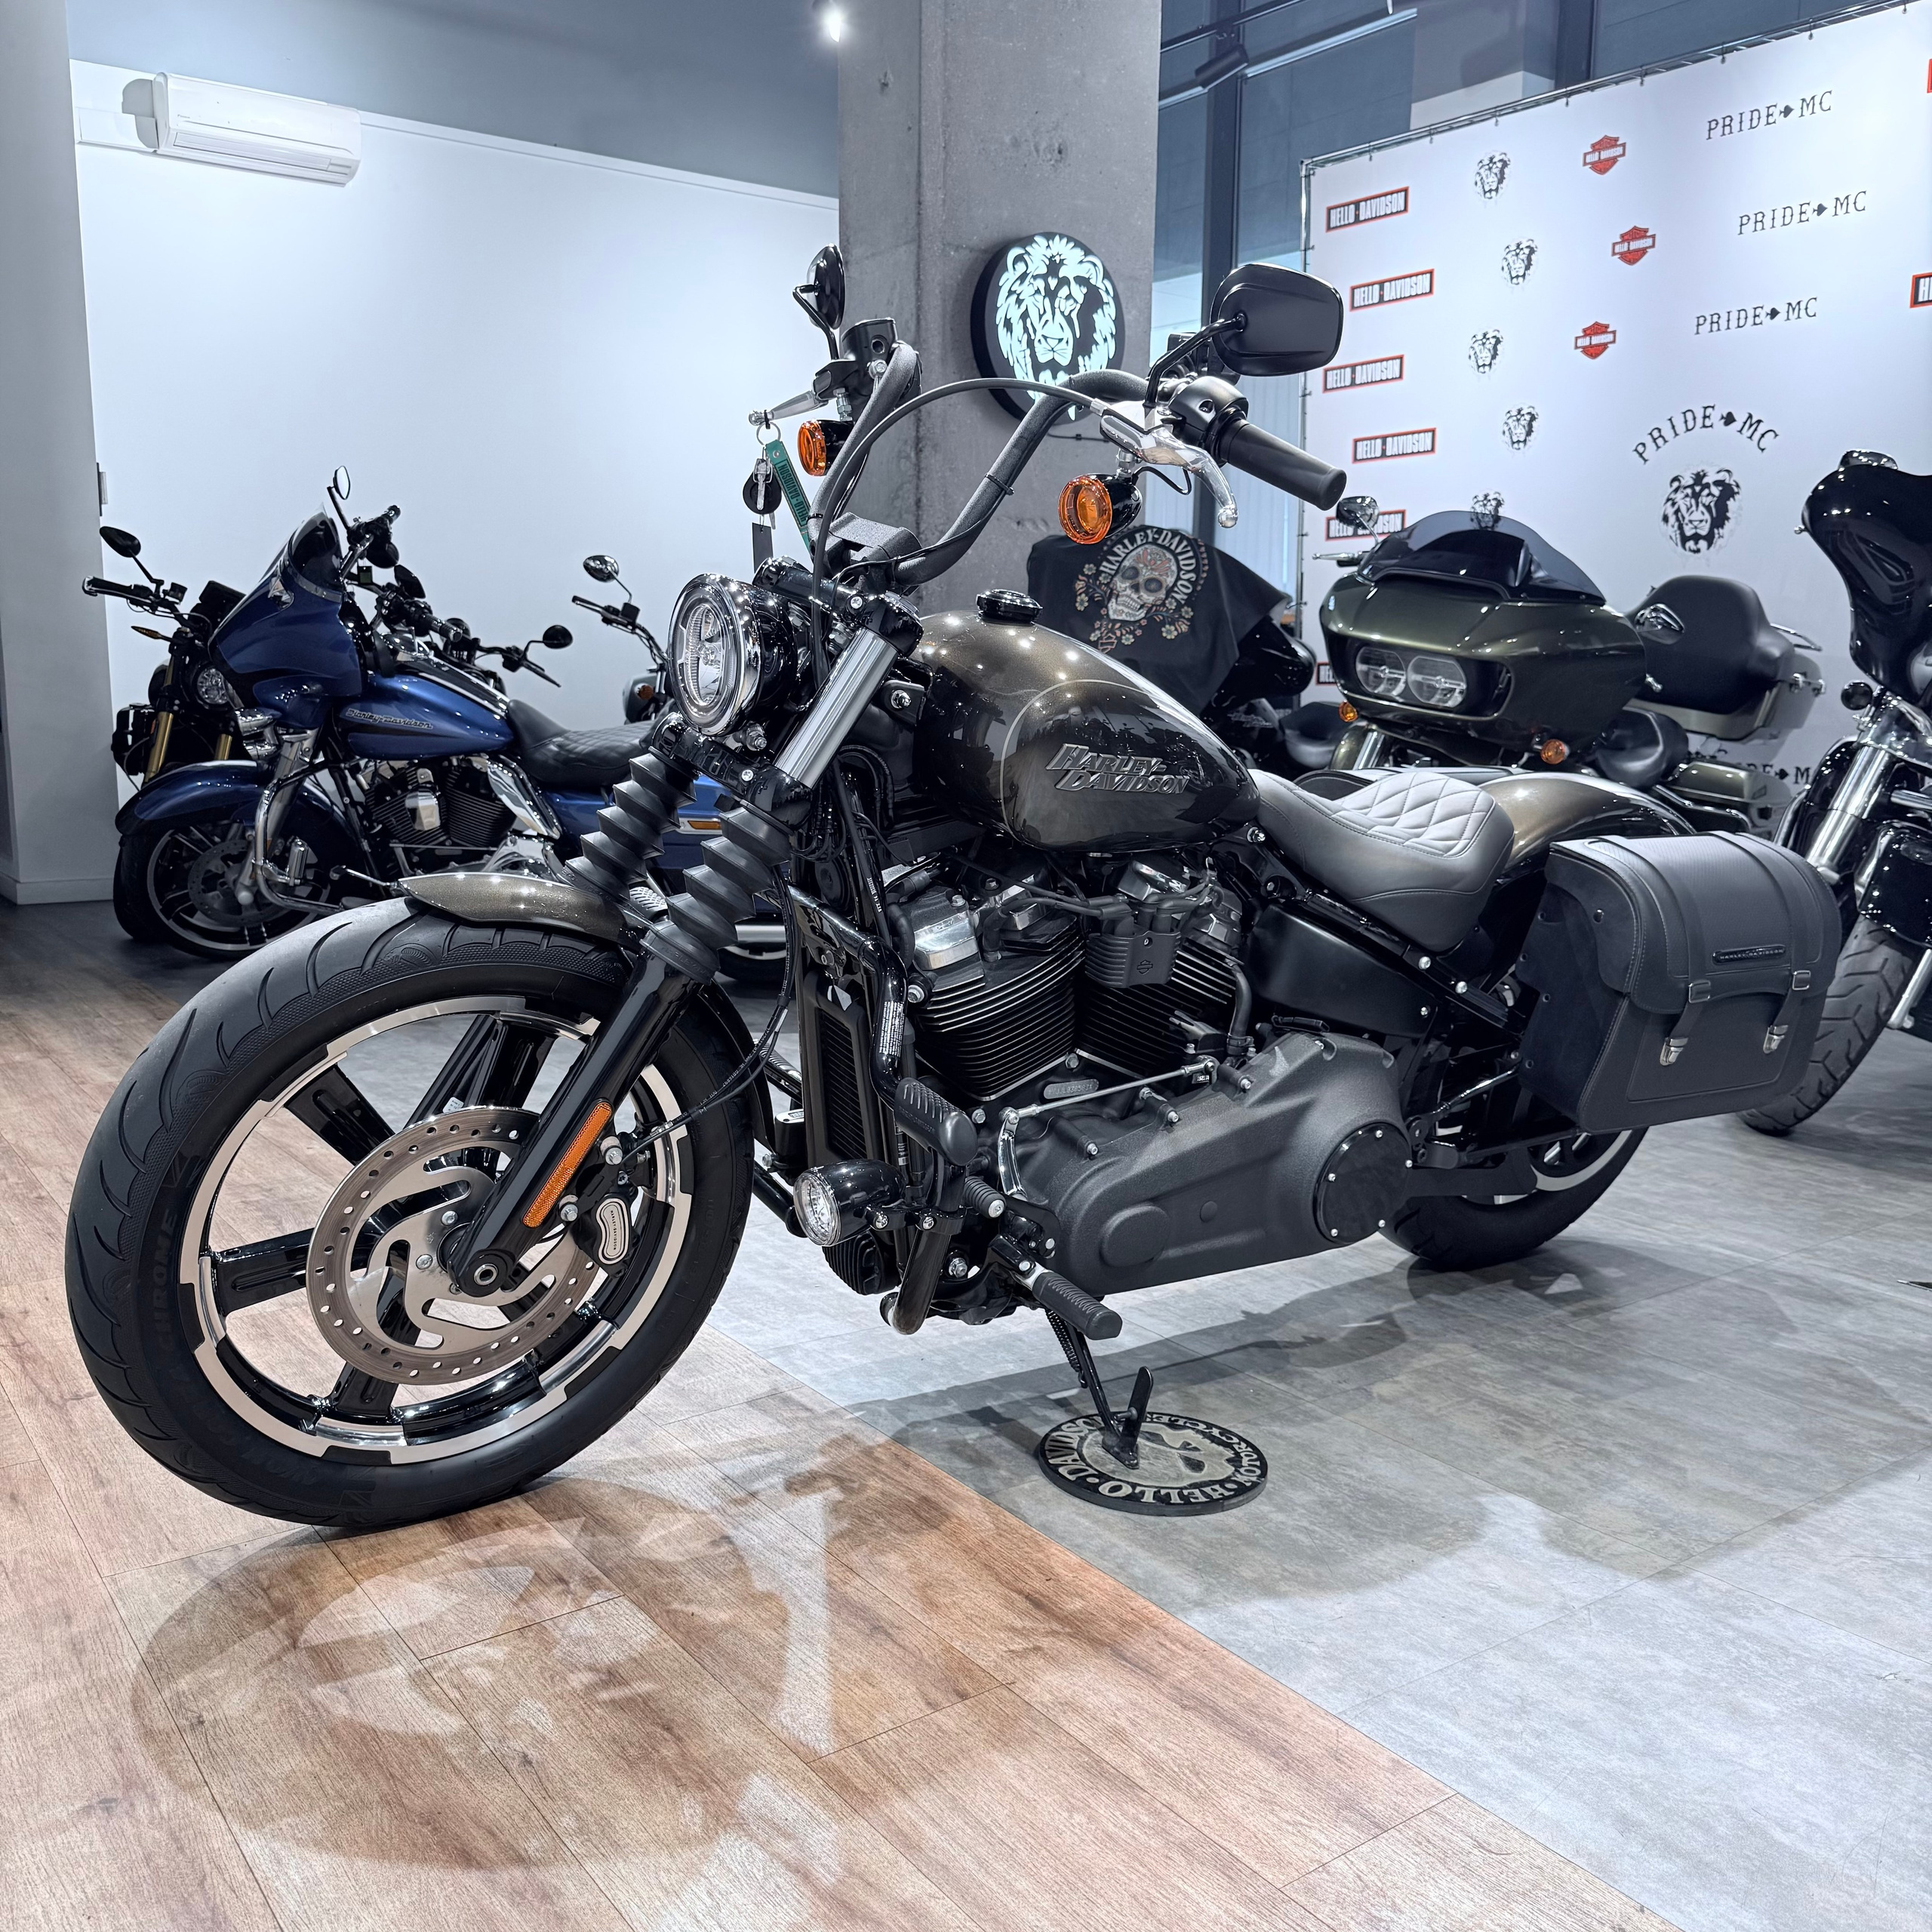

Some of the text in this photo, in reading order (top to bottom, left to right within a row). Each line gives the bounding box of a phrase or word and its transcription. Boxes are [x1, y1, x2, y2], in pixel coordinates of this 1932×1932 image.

[1706, 90, 1832, 140] PRIDE MC
[1330, 191, 1405, 229] HELLO DAVIDSON
[1737, 190, 1867, 235] PRIDE MC
[1353, 273, 1431, 308] HELLO DAVIDSON
[1694, 297, 1817, 335] PRIDE MC
[1326, 358, 1401, 389] HELLO DAVIDSON
[1356, 431, 1433, 460] HELLO DAVIDSON
[1632, 404, 1779, 465] PRIDE MC
[779, 463, 809, 523] HELLO DAVIDSON
[1099, 528, 1197, 605] HARLEY-DAVIDSON
[346, 708, 433, 730] Harley-Davidson
[1055, 769, 1190, 794] DAVIDSON
[152, 1208, 178, 1355] CHROME
[1044, 1415, 1235, 1504] HELLO DAVIDSO
